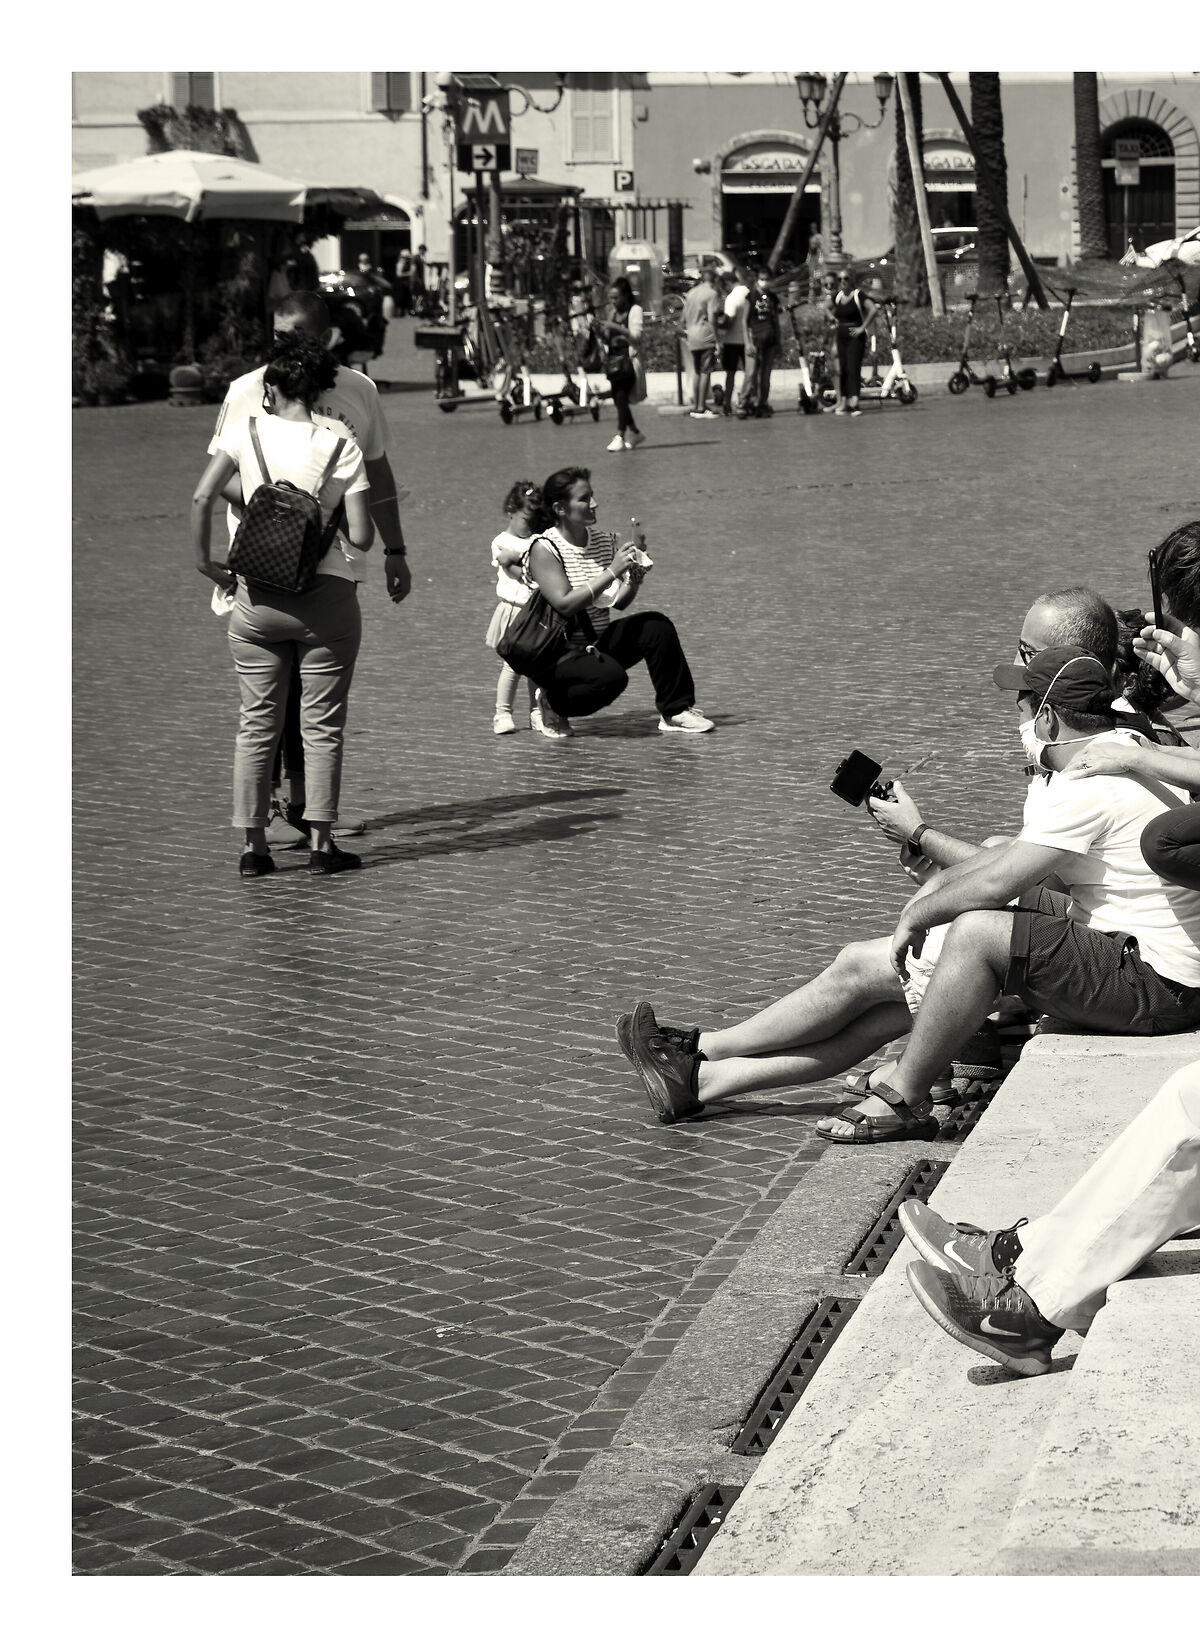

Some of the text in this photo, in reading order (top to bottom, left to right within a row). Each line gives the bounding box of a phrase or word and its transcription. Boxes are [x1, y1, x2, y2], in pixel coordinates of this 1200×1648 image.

[462, 98, 506, 134] M
[1119, 144, 1139, 152] TAXI
[741, 158, 805, 170] ESCADA
[924, 156, 975, 170] SCADA
[616, 172, 632, 191] P
